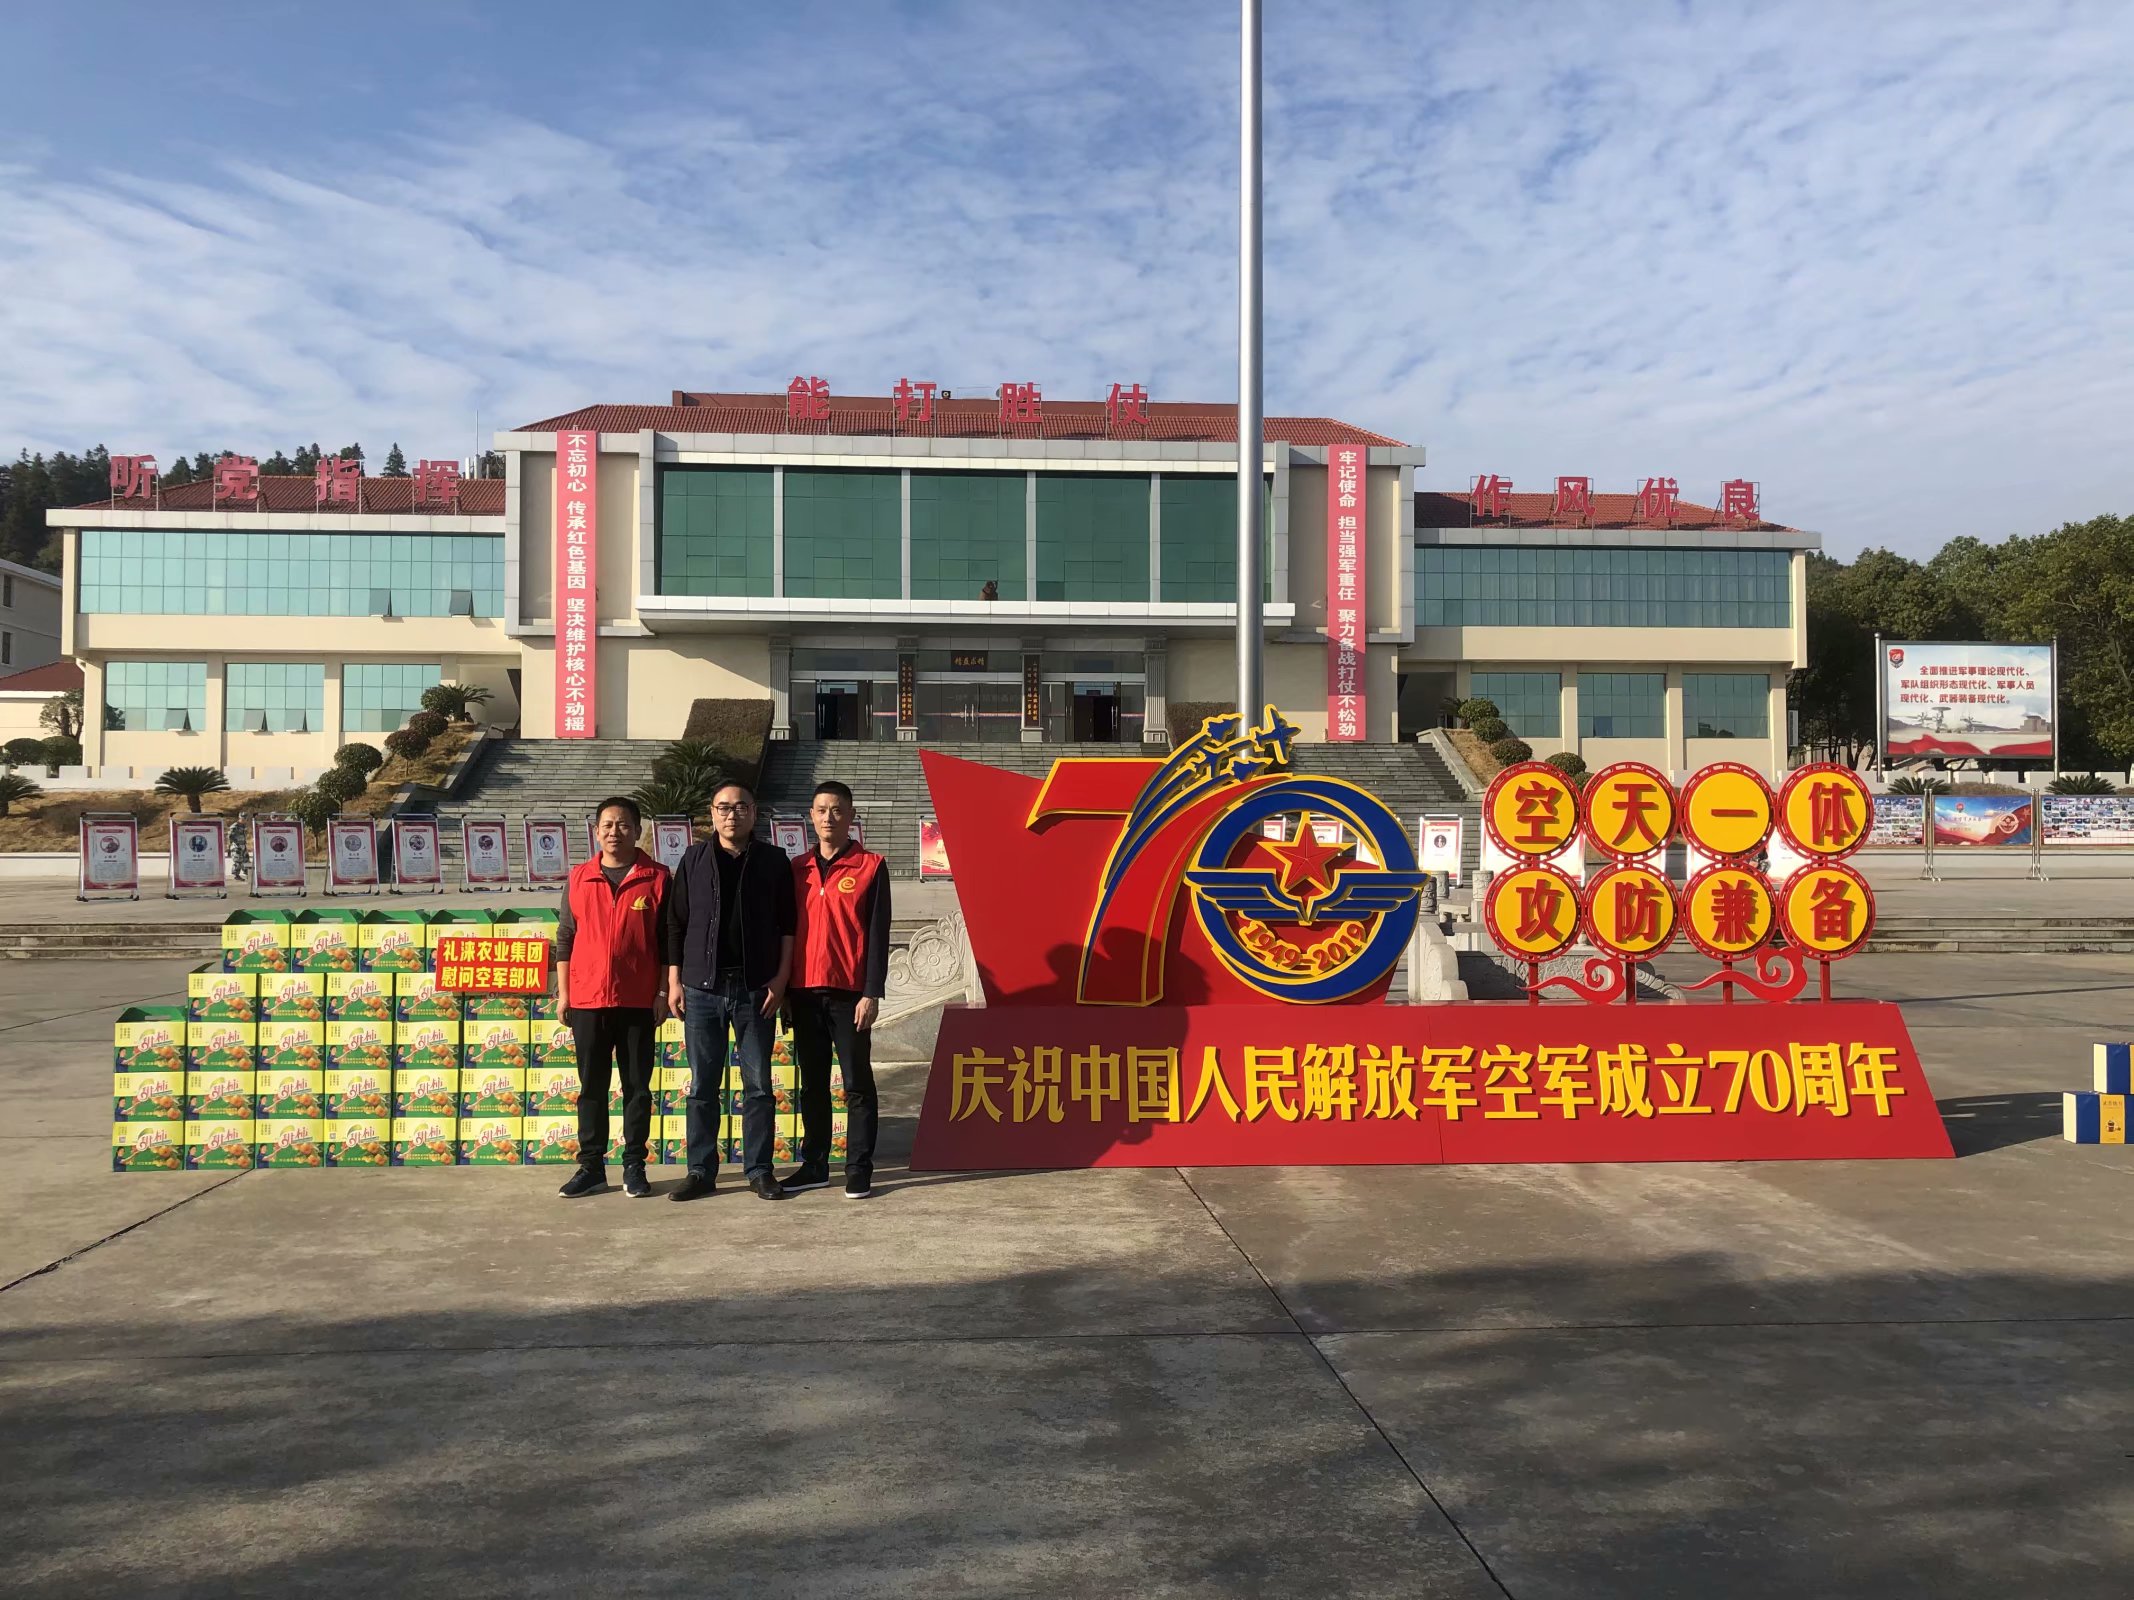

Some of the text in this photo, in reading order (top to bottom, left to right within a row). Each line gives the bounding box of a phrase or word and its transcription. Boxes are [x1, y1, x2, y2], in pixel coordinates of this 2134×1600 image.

[788, 376, 1150, 426] 能打胜仗
[110, 454, 460, 503] 听党指挥
[1471, 474, 1760, 521] 作风优良
[564, 434, 587, 731] 不忘初心 传承红色基因 坚决维护核心不动摇
[1337, 450, 1357, 737] 牢记使命 担当强军重任 聚力备战打仗不松劲
[1514, 780, 1858, 847] 空天一体
[1515, 876, 1854, 944] 攻防兼备
[1244, 920, 1368, 972] 1949-2019
[441, 966, 541, 989] 慰问空军部队
[948, 1042, 1906, 1124] 庆祝中国人民解放军空军成立70周年
